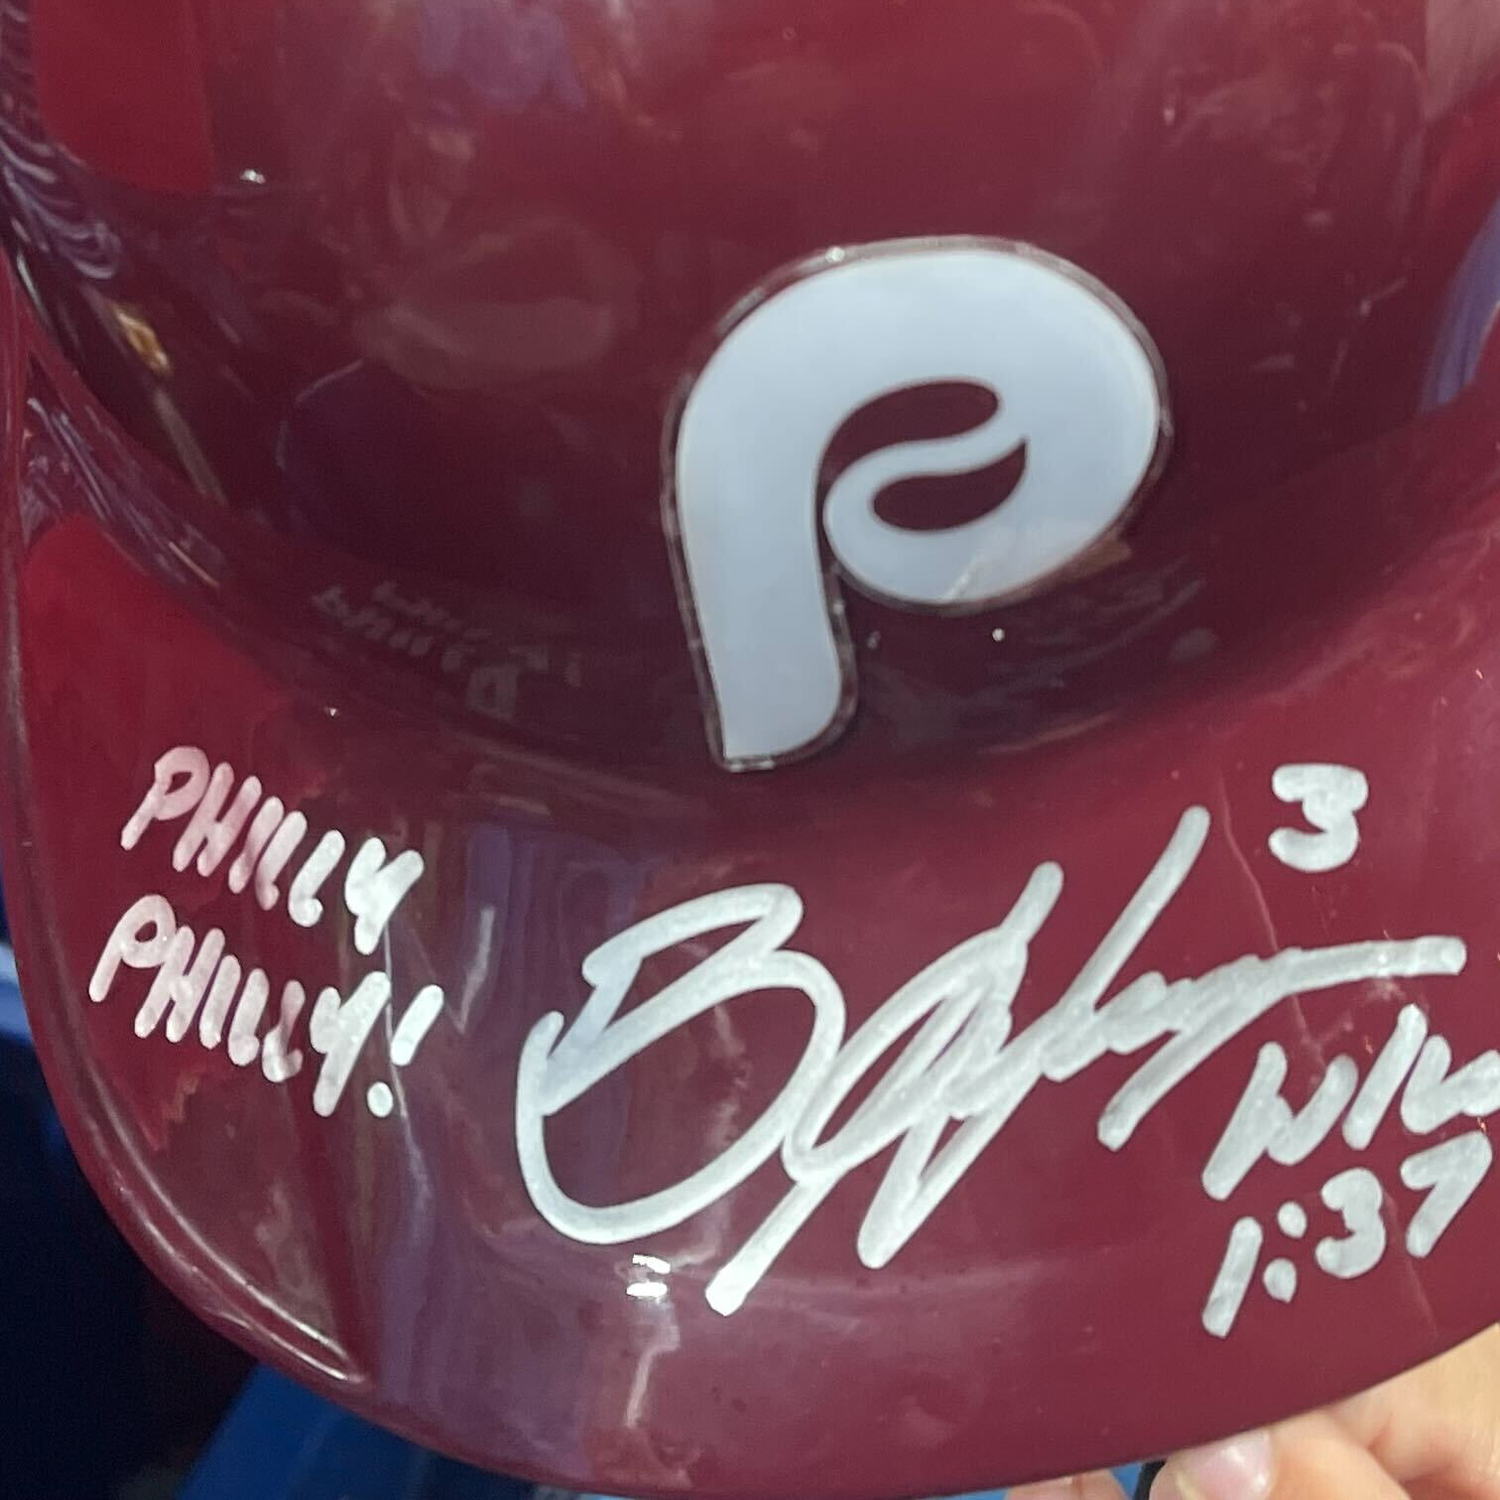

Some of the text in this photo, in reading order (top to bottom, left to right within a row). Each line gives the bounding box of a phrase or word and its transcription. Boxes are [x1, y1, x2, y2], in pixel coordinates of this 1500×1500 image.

[664, 238, 1170, 771] P
[120, 746, 425, 955] PHILLY
[1268, 763, 1369, 872] 3
[88, 895, 445, 1117] PHILLY!
[1202, 1131, 1493, 1338] 1:37
